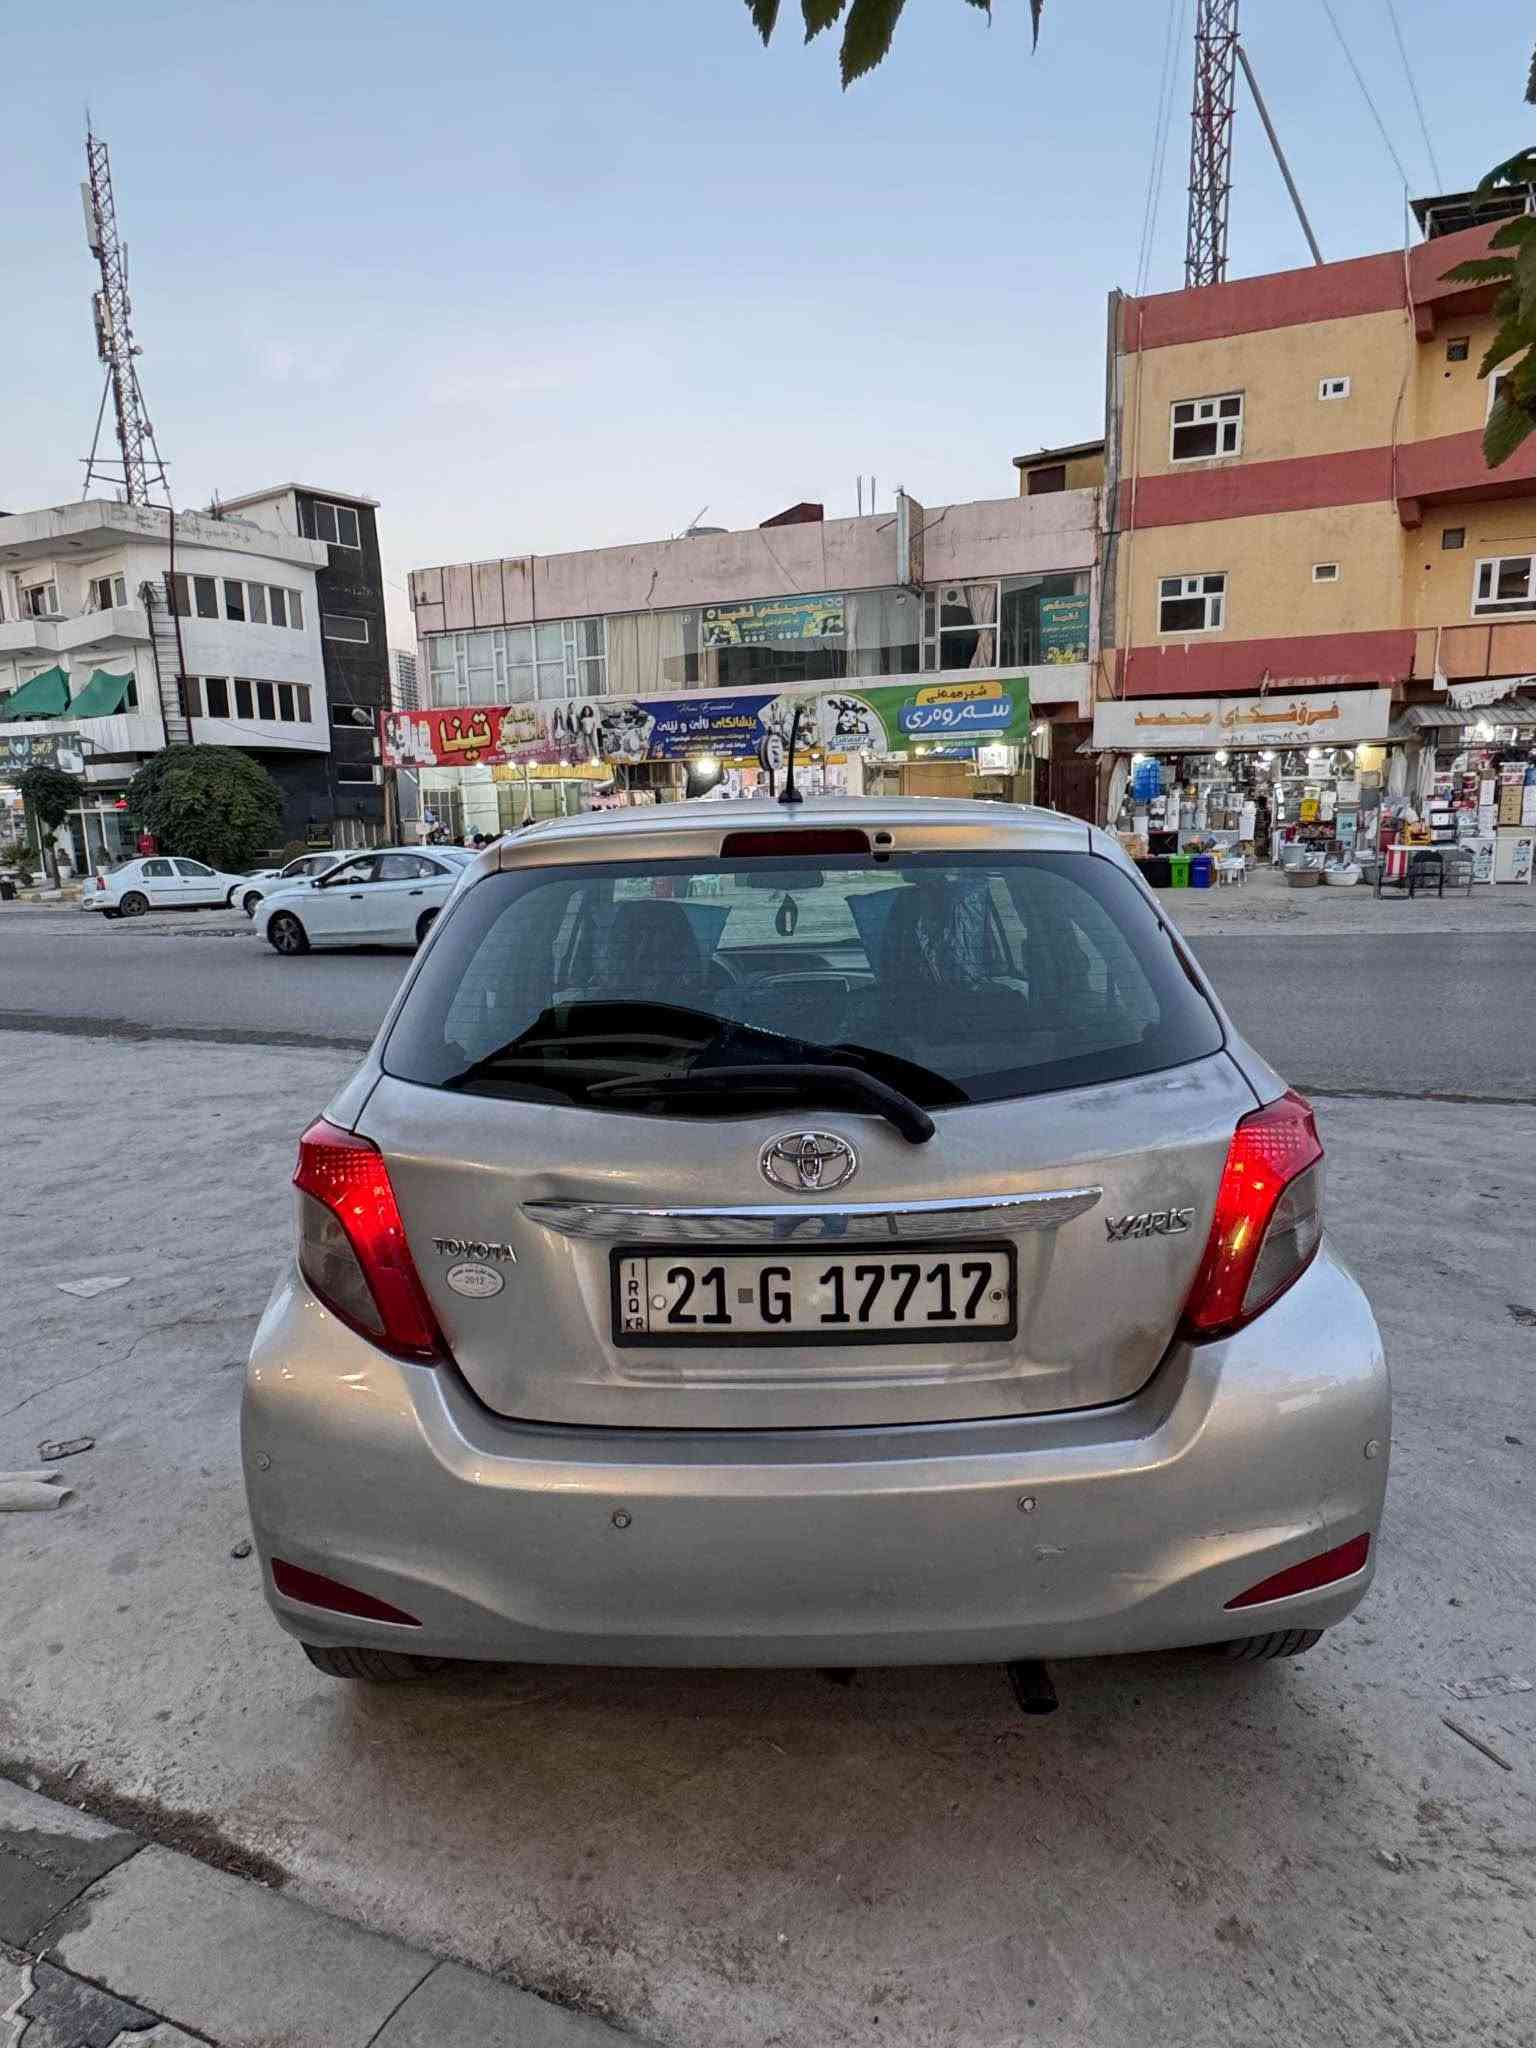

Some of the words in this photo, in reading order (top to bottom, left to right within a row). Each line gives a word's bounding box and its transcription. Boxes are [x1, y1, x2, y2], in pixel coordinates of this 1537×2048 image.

[904, 702, 1010, 730] سەروەری
[432, 1237, 518, 1264] TOYOTA
[667, 1265, 732, 1324] 21
[759, 1265, 792, 1324] G
[820, 1262, 993, 1324] 17717
[625, 1317, 643, 1330] KR
